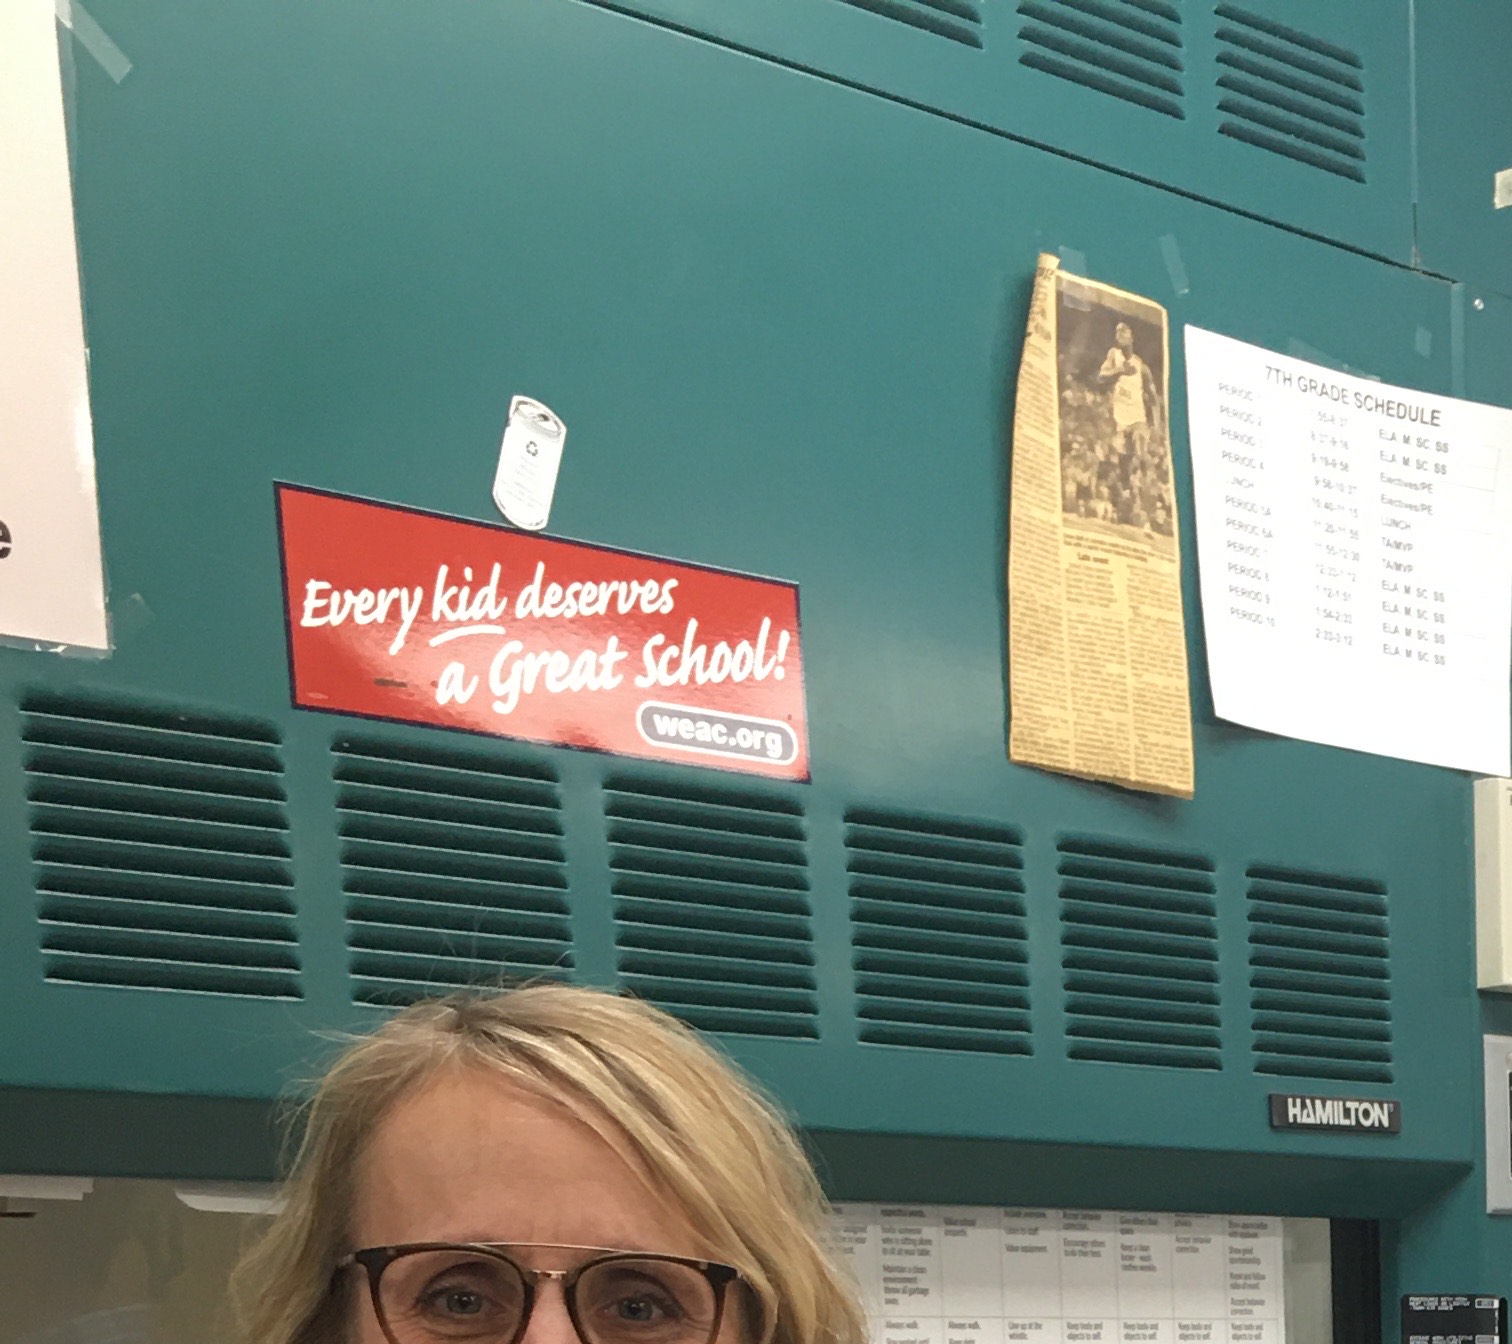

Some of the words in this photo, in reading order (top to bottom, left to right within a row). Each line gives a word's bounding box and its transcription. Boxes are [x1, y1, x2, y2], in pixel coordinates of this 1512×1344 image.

[1265, 365, 1293, 388] 7TH
[1297, 376, 1349, 405] GRADE
[1353, 391, 1441, 427] SCHEDULE
[300, 578, 423, 656] Every
[431, 561, 508, 622] kid
[515, 560, 679, 619] deserves
[435, 661, 479, 705] a
[489, 635, 628, 715] Great
[634, 616, 791, 689] School!
[652, 712, 783, 758] weac.org
[1287, 1097, 1390, 1128] HAMILTON
